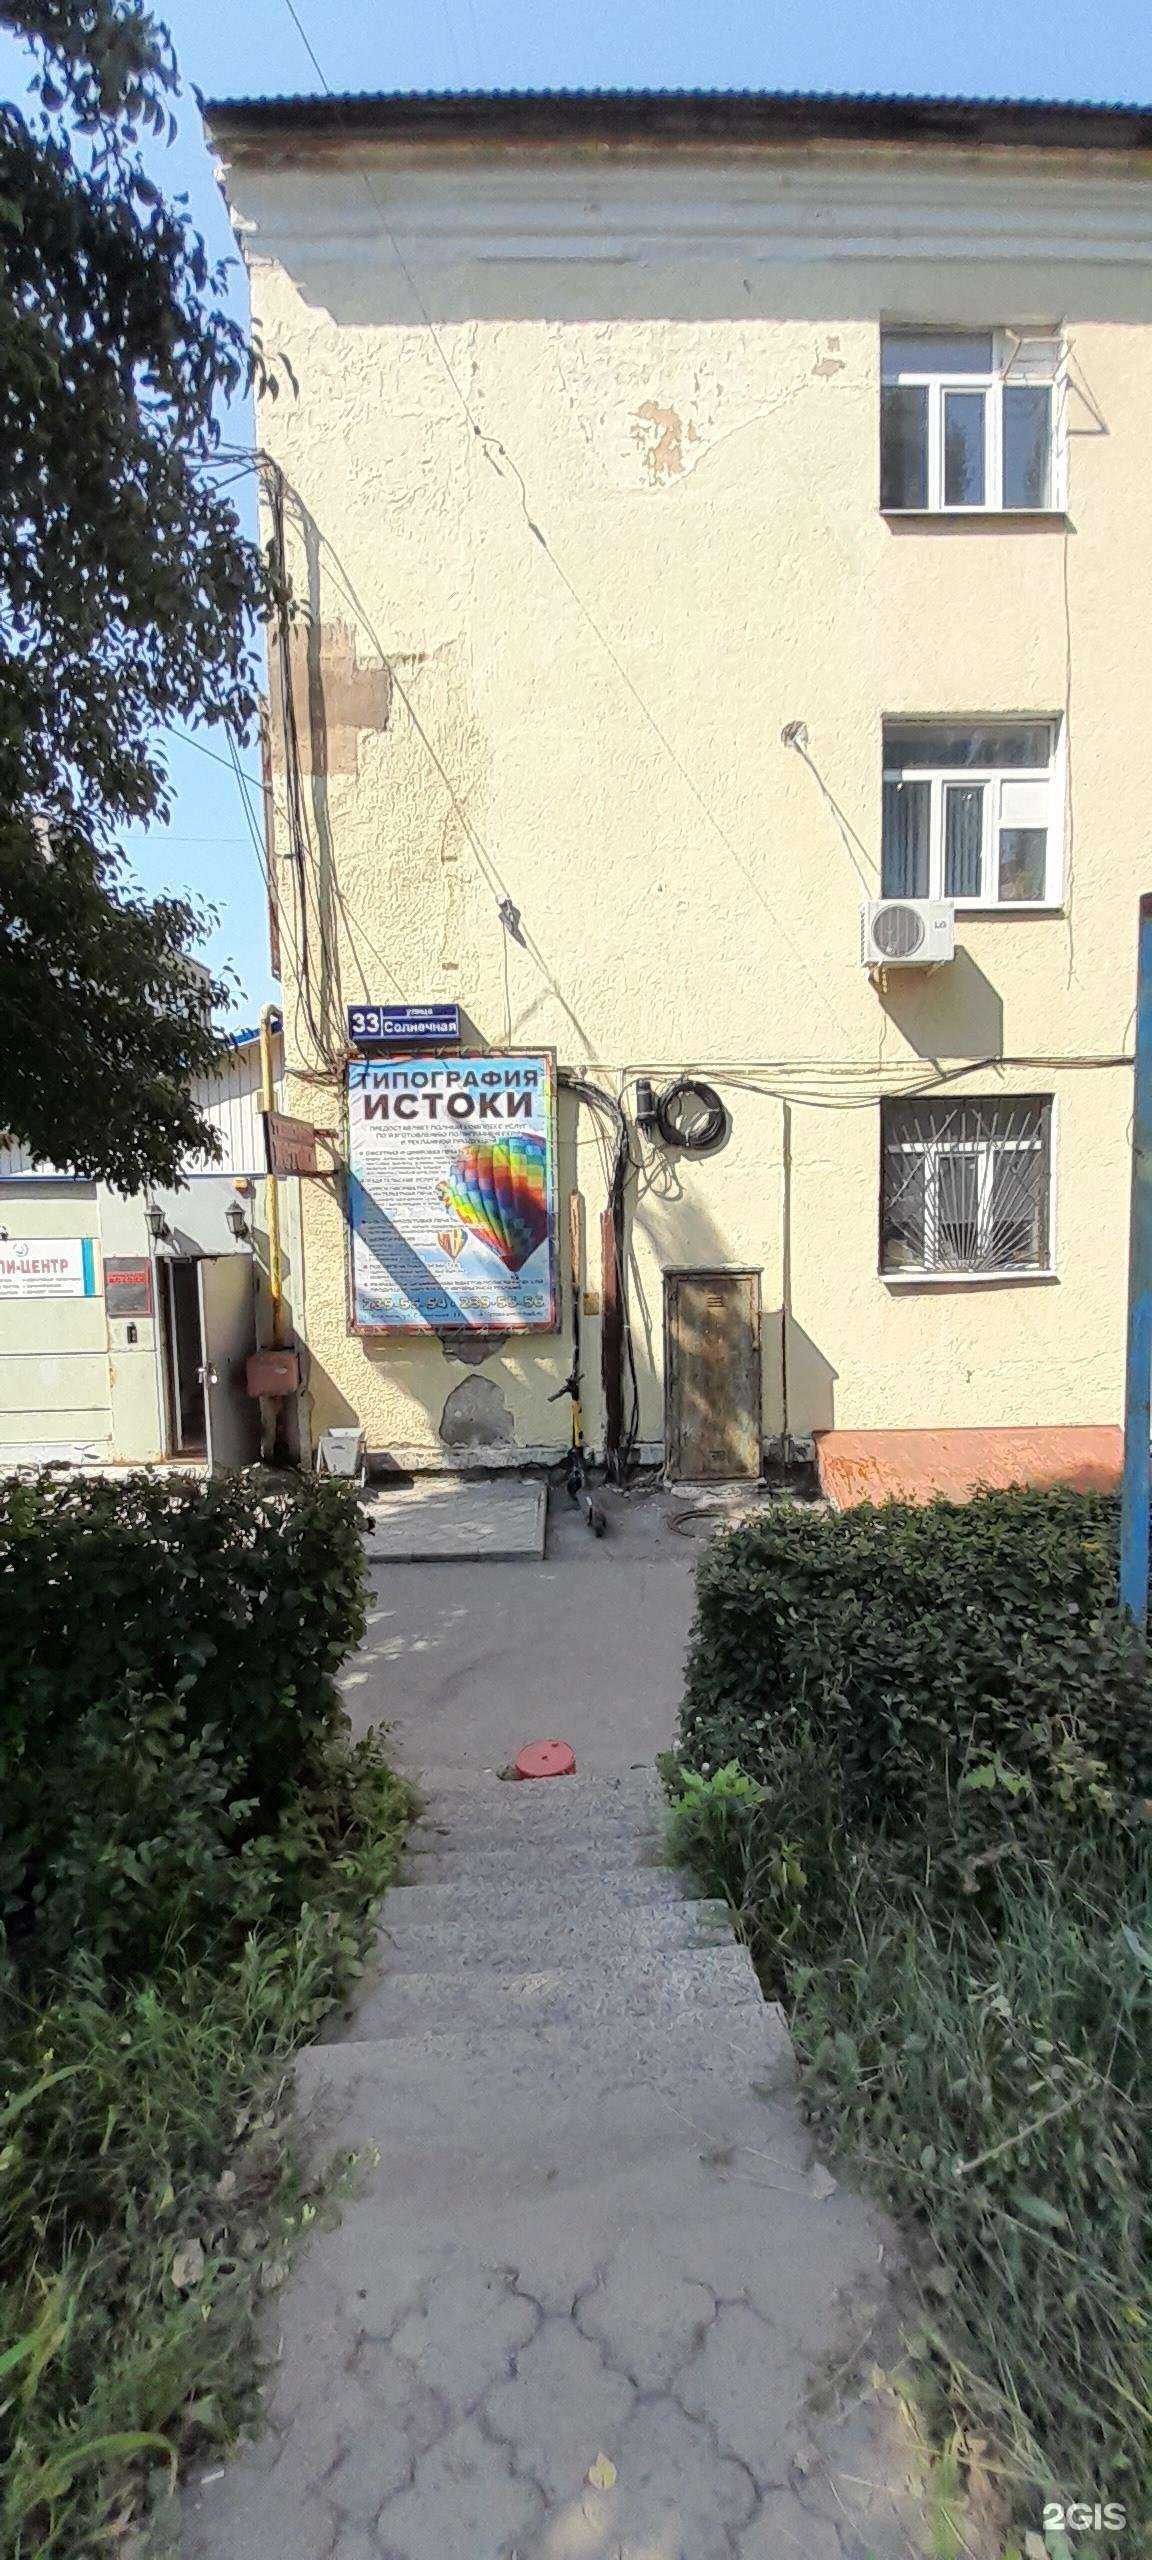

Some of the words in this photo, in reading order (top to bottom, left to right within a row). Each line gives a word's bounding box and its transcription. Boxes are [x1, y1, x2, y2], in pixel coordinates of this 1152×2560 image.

[352, 1013, 380, 1033] 33
[384, 1021, 457, 1033] Солнечная
[359, 1069, 538, 1090] ТИПОГРАФИЯ
[364, 1092, 533, 1120] ИСТОКИ
